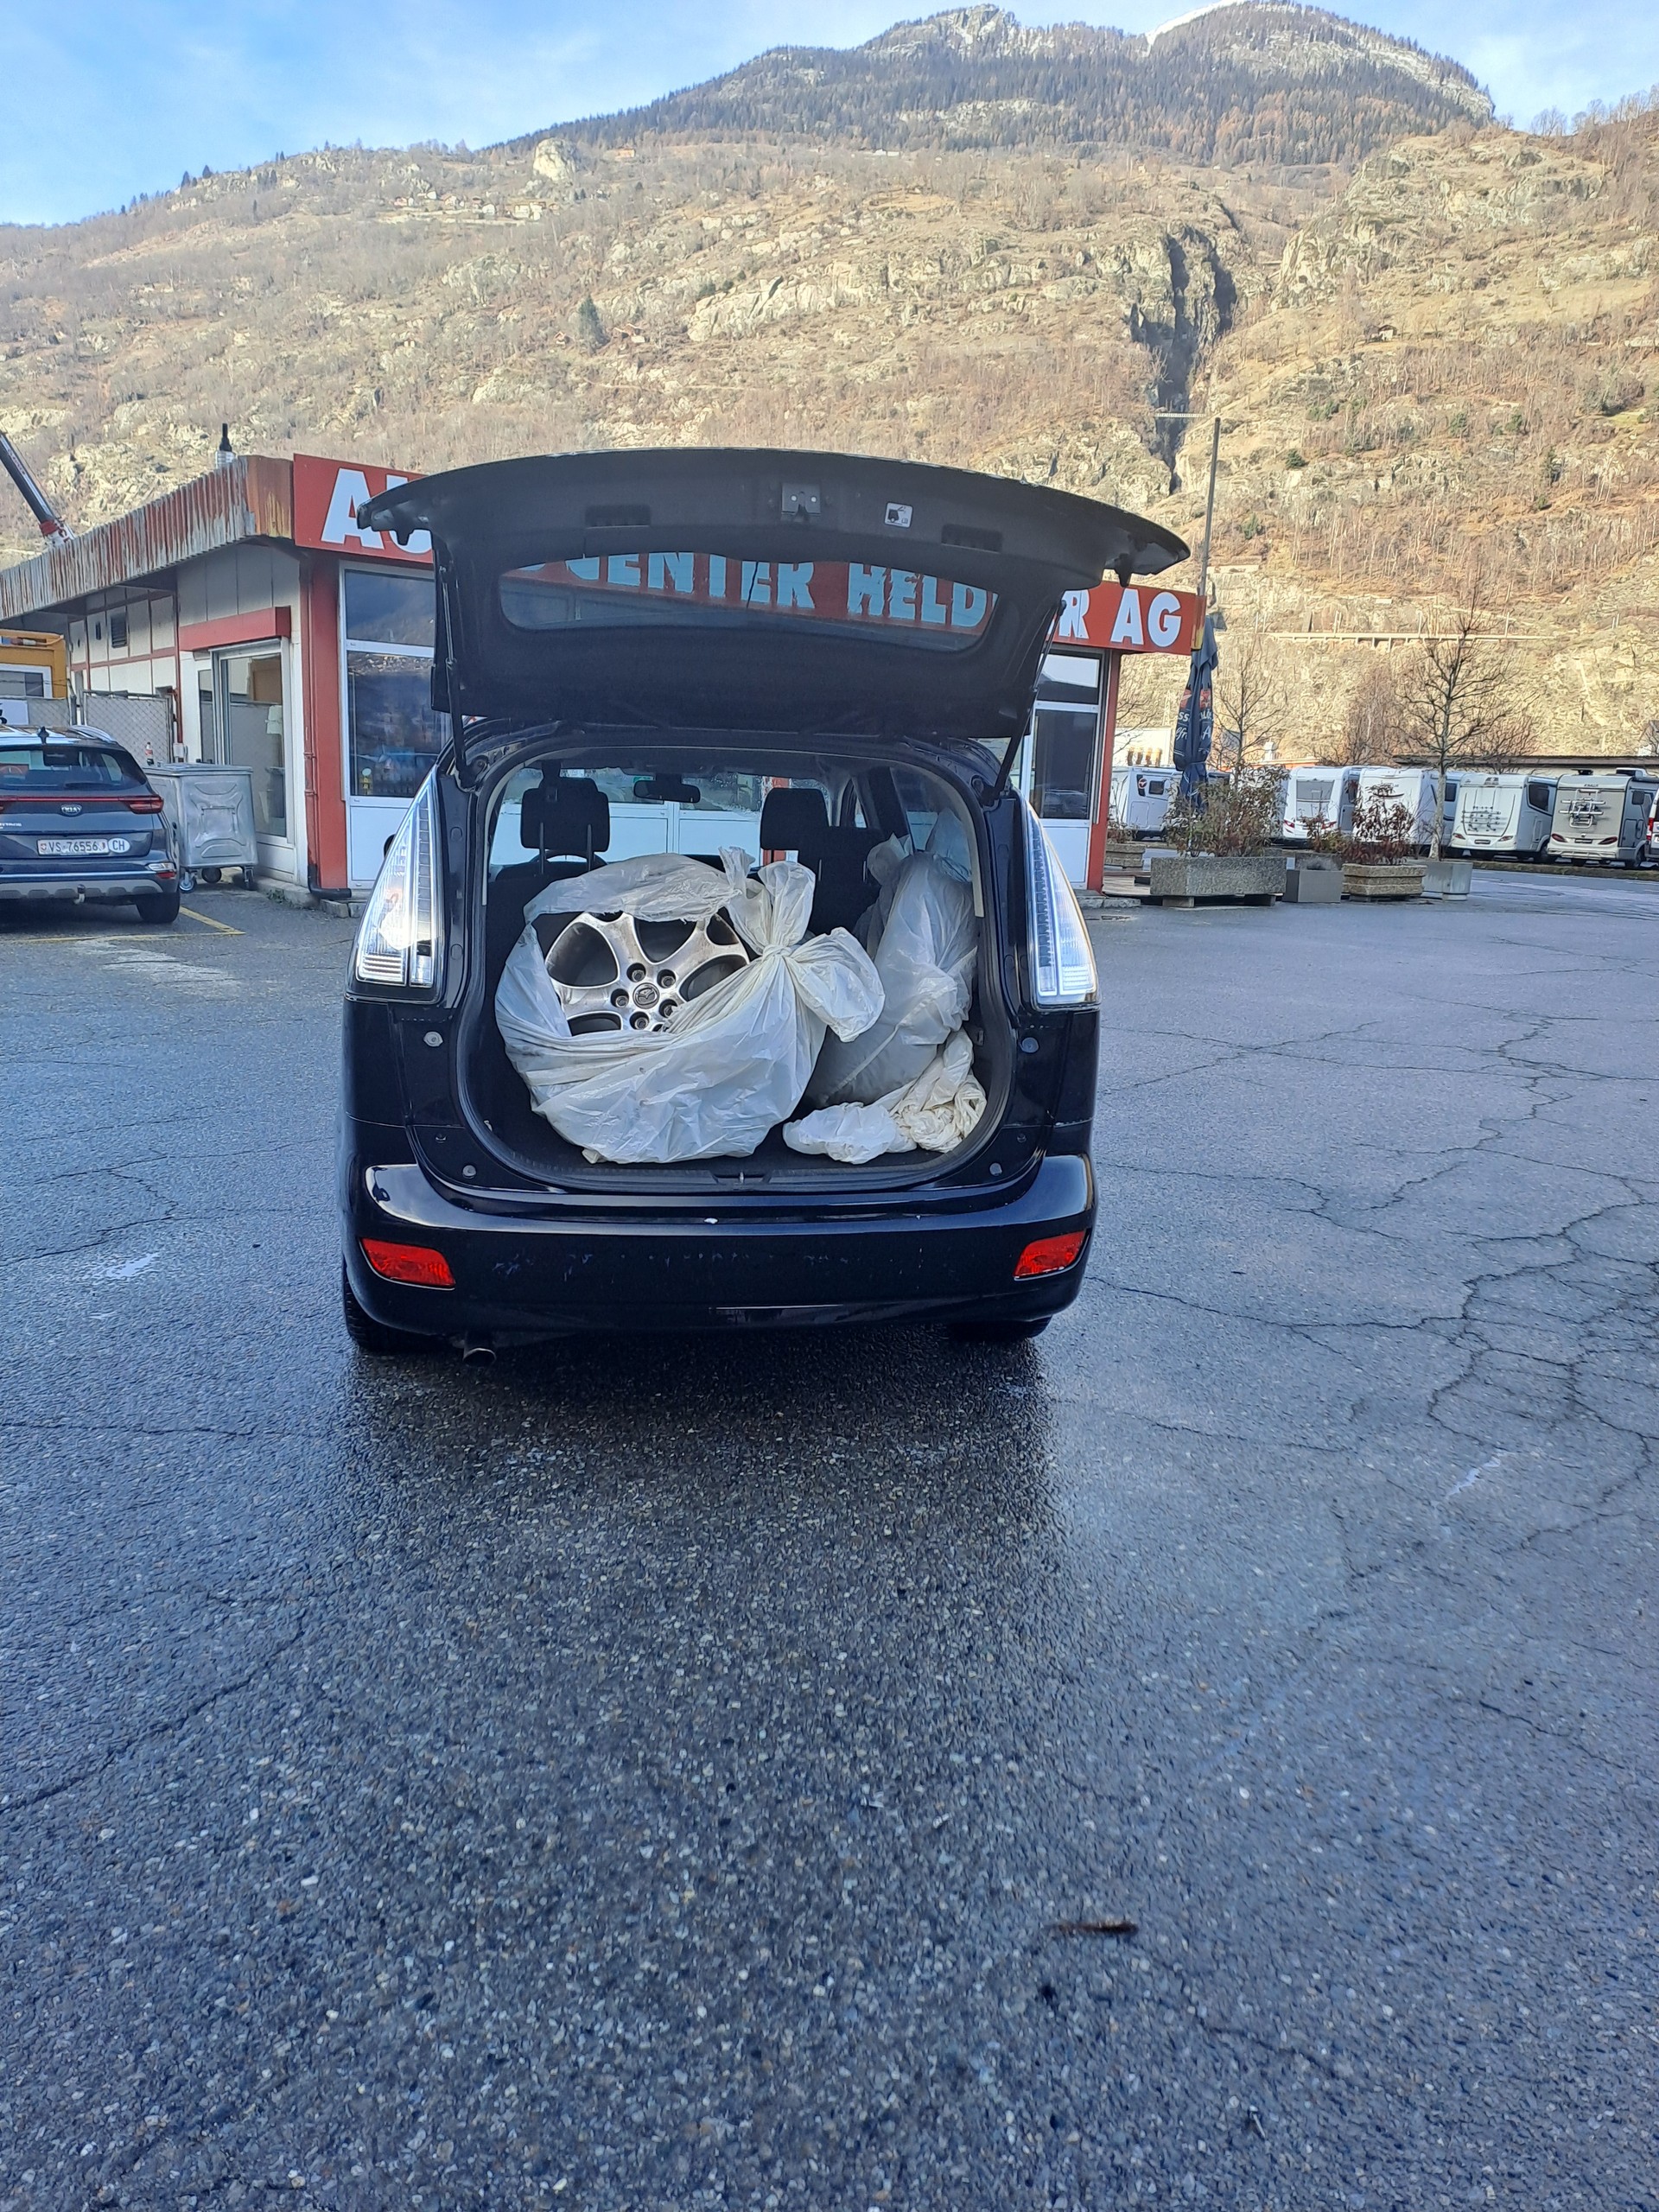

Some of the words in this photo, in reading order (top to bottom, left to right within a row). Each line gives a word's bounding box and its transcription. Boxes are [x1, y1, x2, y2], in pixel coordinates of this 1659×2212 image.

[848, 563, 1090, 639] HELDR
[1110, 588, 1181, 647] AG
[112, 840, 125, 851] CH
